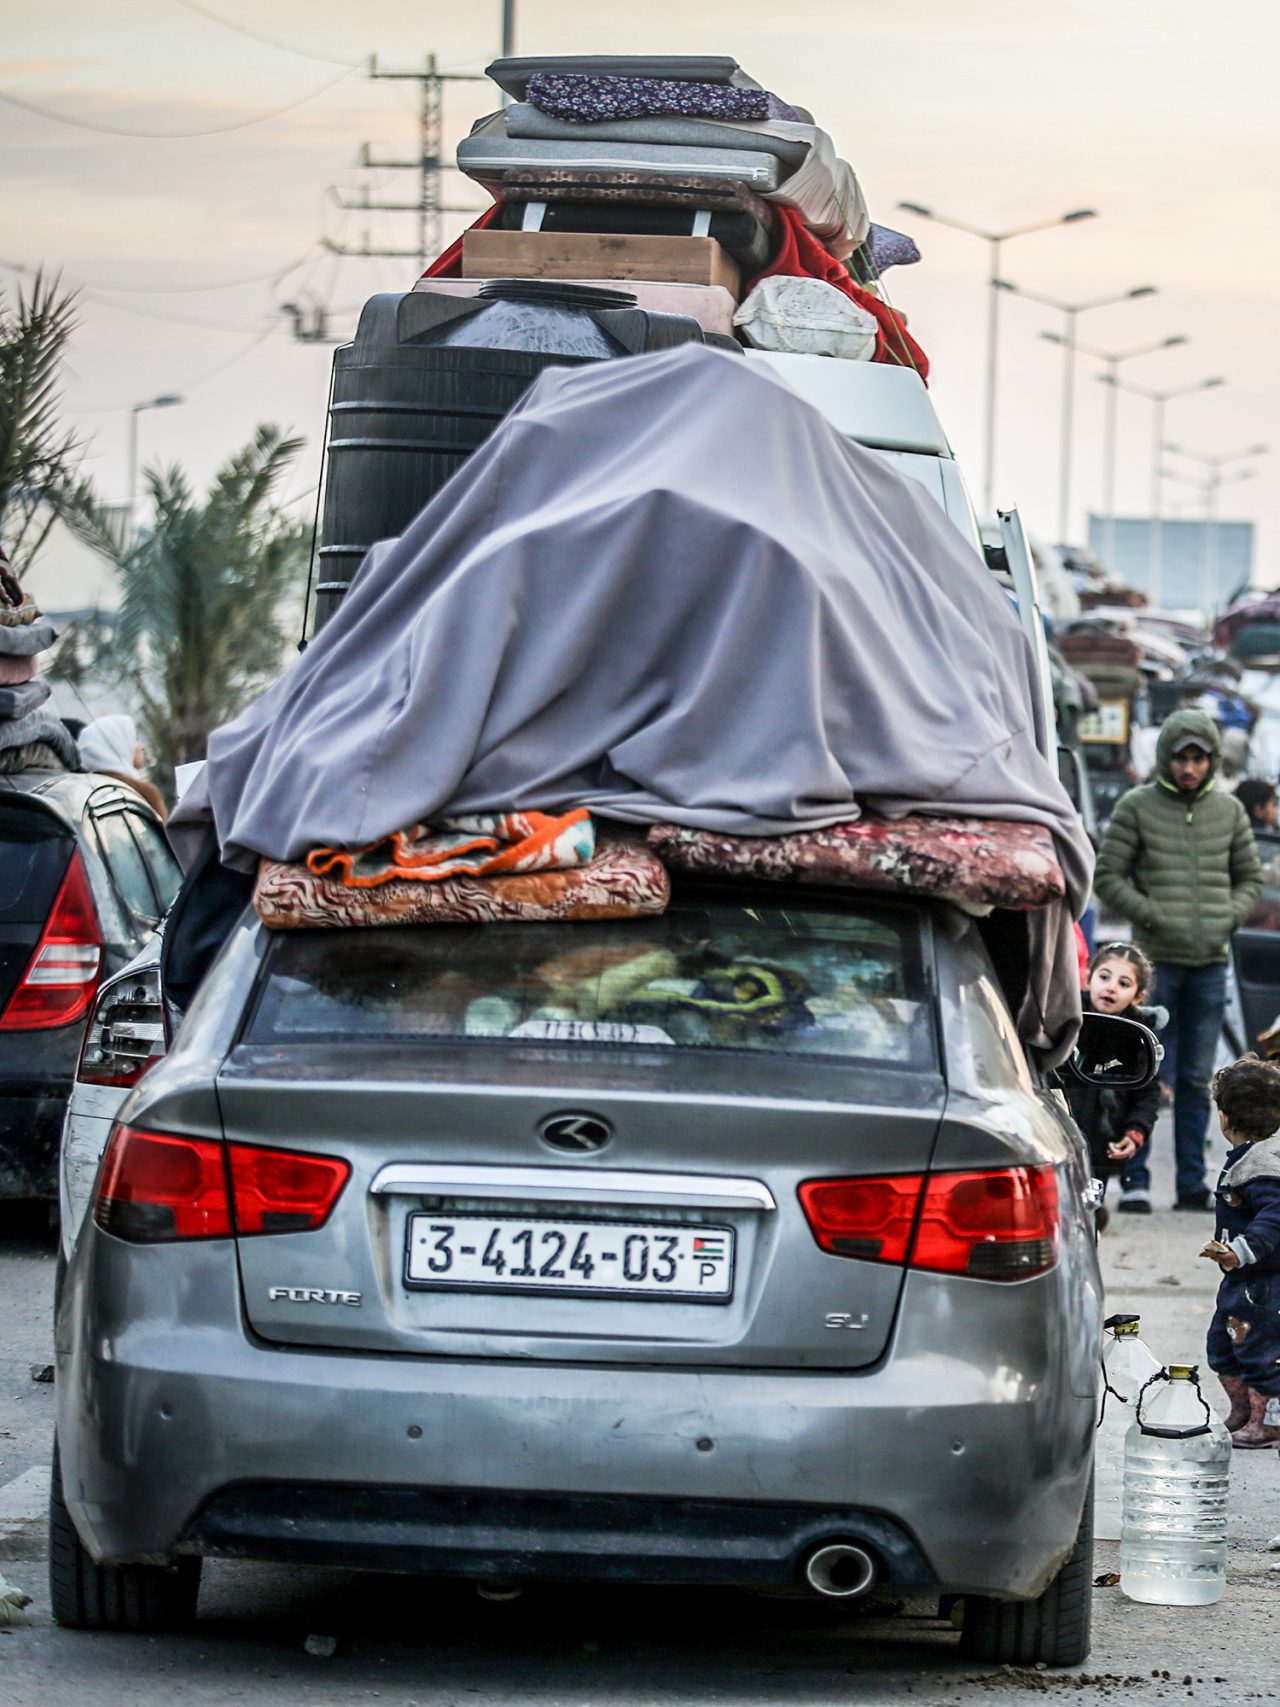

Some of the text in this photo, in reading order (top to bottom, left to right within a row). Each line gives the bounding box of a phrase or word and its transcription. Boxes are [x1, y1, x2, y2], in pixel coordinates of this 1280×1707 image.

[427, 1224, 679, 1283] 3-4124-03
[699, 1263, 716, 1285] P
[268, 1286, 362, 1307] FORTE
